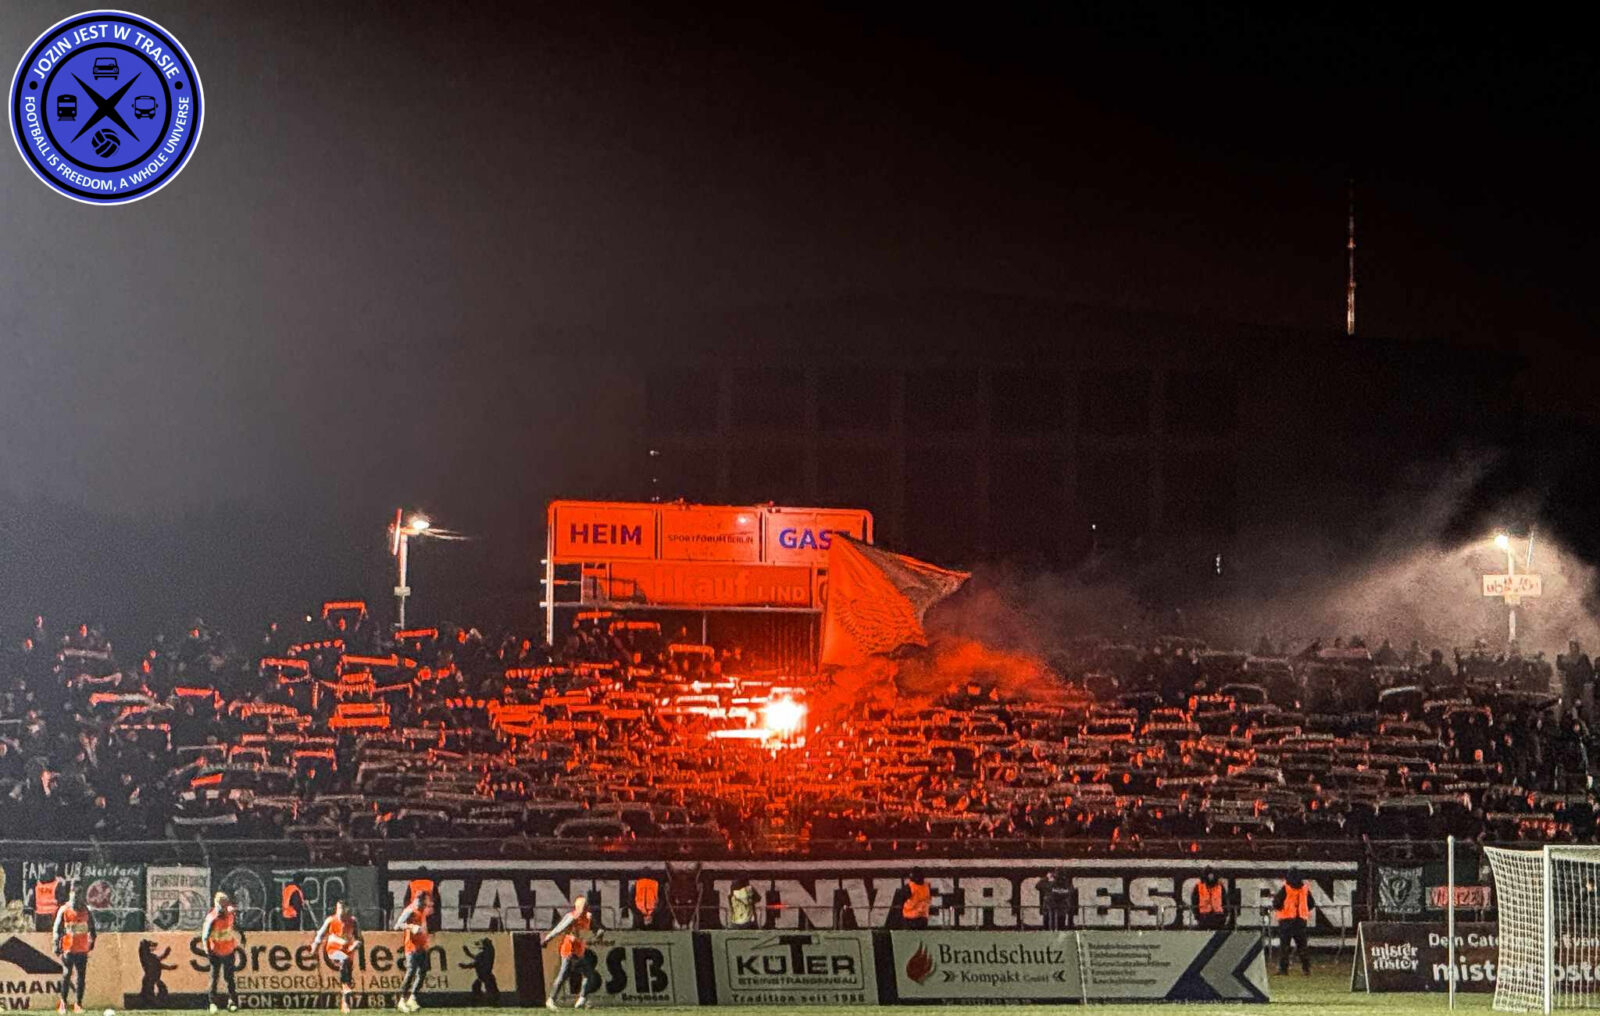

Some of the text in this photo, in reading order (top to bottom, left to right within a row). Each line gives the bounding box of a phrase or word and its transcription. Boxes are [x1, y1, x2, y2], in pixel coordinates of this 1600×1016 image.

[570, 523, 642, 545] HEIM
[778, 528, 842, 550] GAS
[1428, 932, 1464, 947] Den
[736, 935, 856, 975] KÜTER
[938, 943, 1065, 965] Brandschutz
[1371, 942, 1419, 960] mister
[369, 975, 449, 989] ABBCH
[961, 970, 1021, 986] Kompakt
[0, 980, 77, 994] MAN
[283, 994, 320, 1008] 0177
[732, 993, 795, 1003] Tradition
[801, 993, 827, 1003] seit
